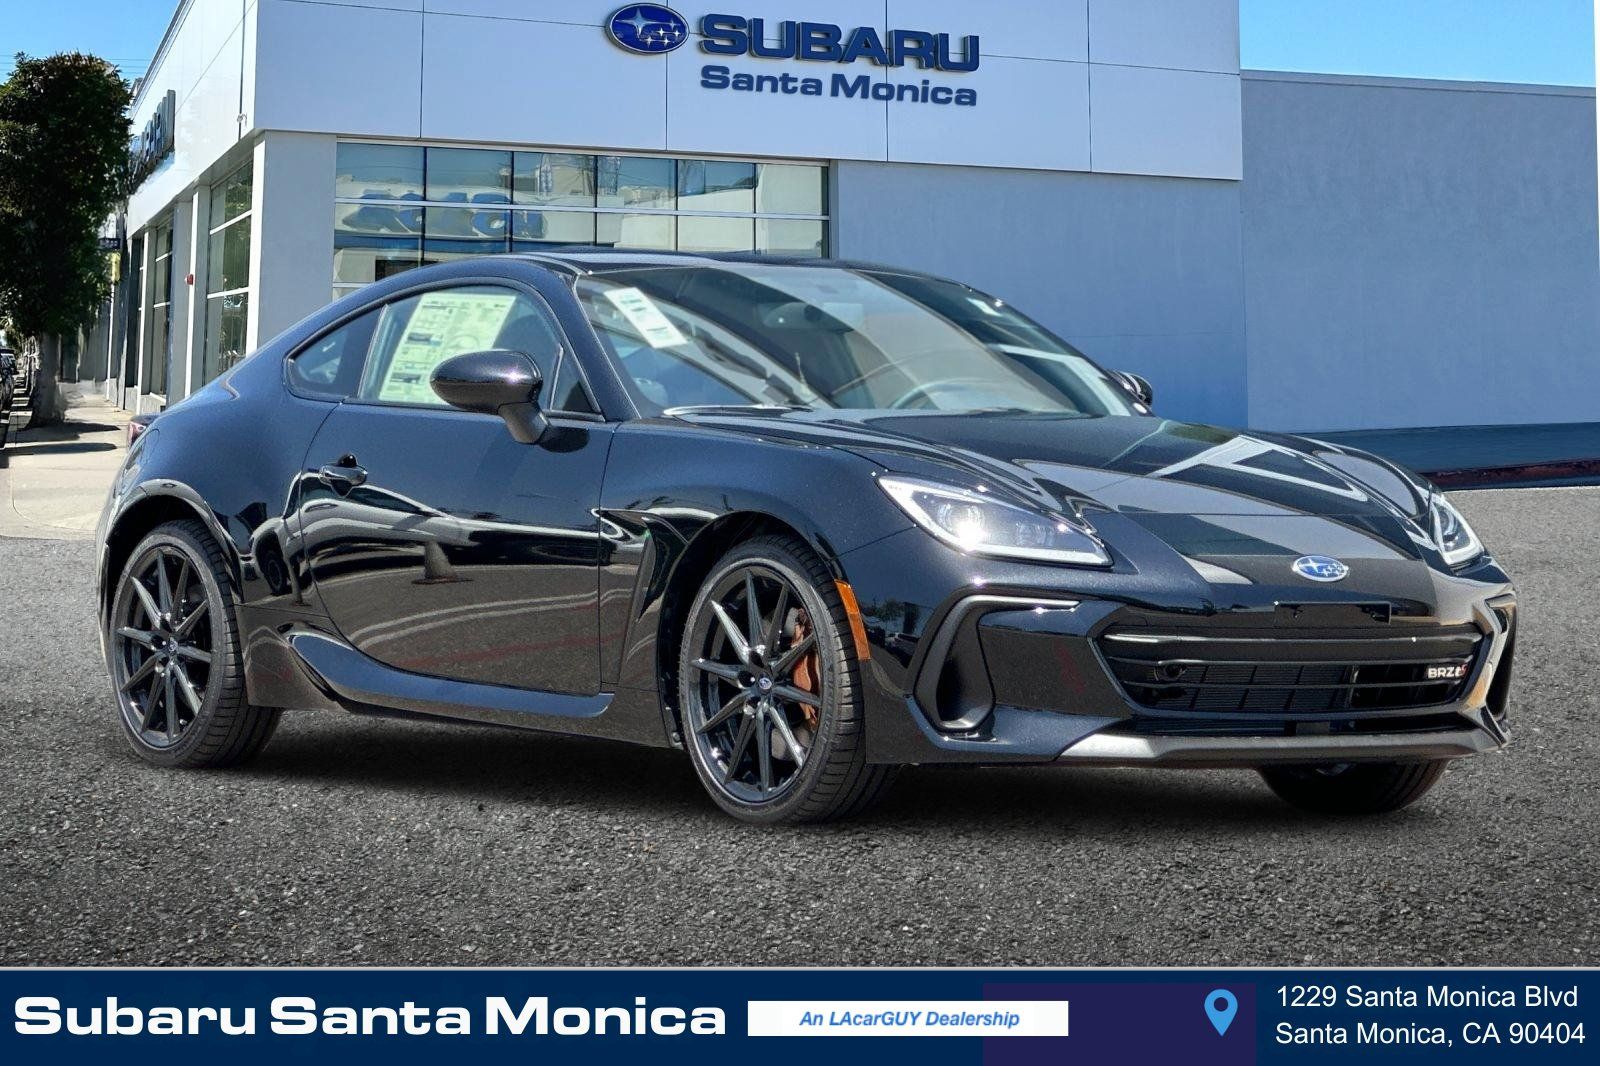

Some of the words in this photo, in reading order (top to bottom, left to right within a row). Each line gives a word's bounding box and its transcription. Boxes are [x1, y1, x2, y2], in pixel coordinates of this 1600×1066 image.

[700, 13, 980, 72] SUBARU
[700, 65, 823, 97] Santa
[830, 73, 978, 106] Monica
[1427, 666, 1455, 679] BRZ
